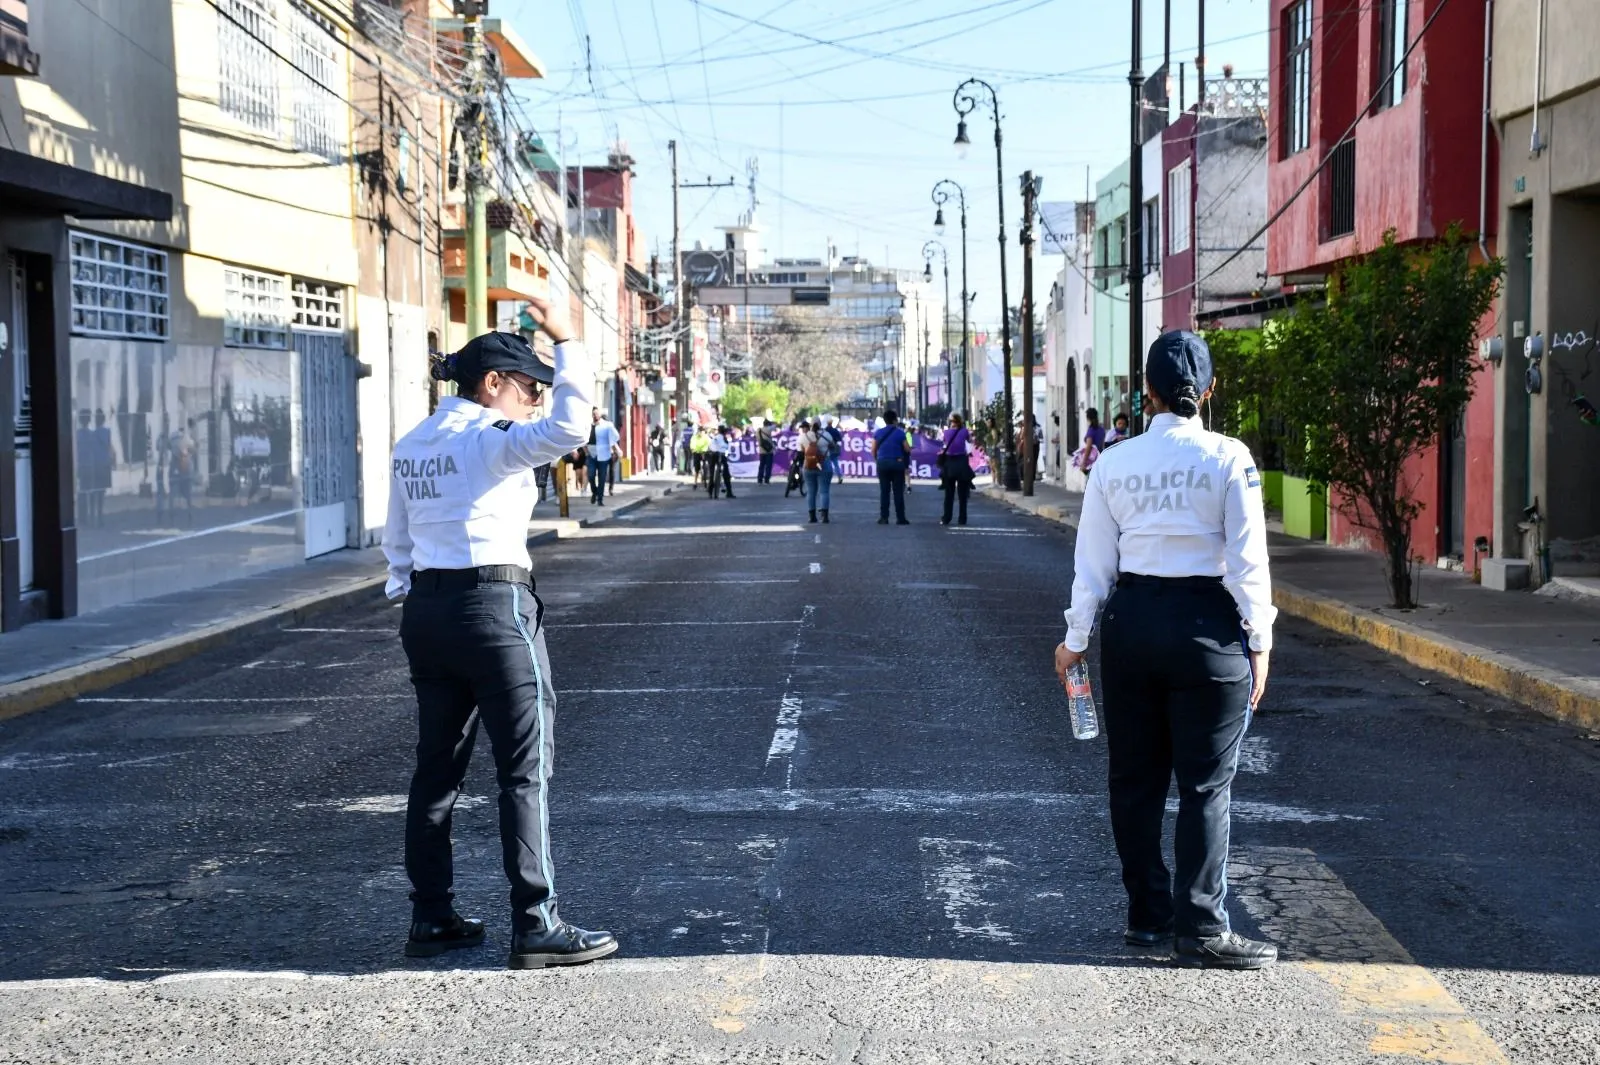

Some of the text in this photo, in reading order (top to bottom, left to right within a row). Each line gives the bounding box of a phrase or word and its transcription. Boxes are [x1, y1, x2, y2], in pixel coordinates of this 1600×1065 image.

[393, 454, 459, 478] POLICÍA
[405, 480, 442, 500] VIAL
[1107, 465, 1212, 497] POLICÍA
[1132, 492, 1190, 514] VIAL
